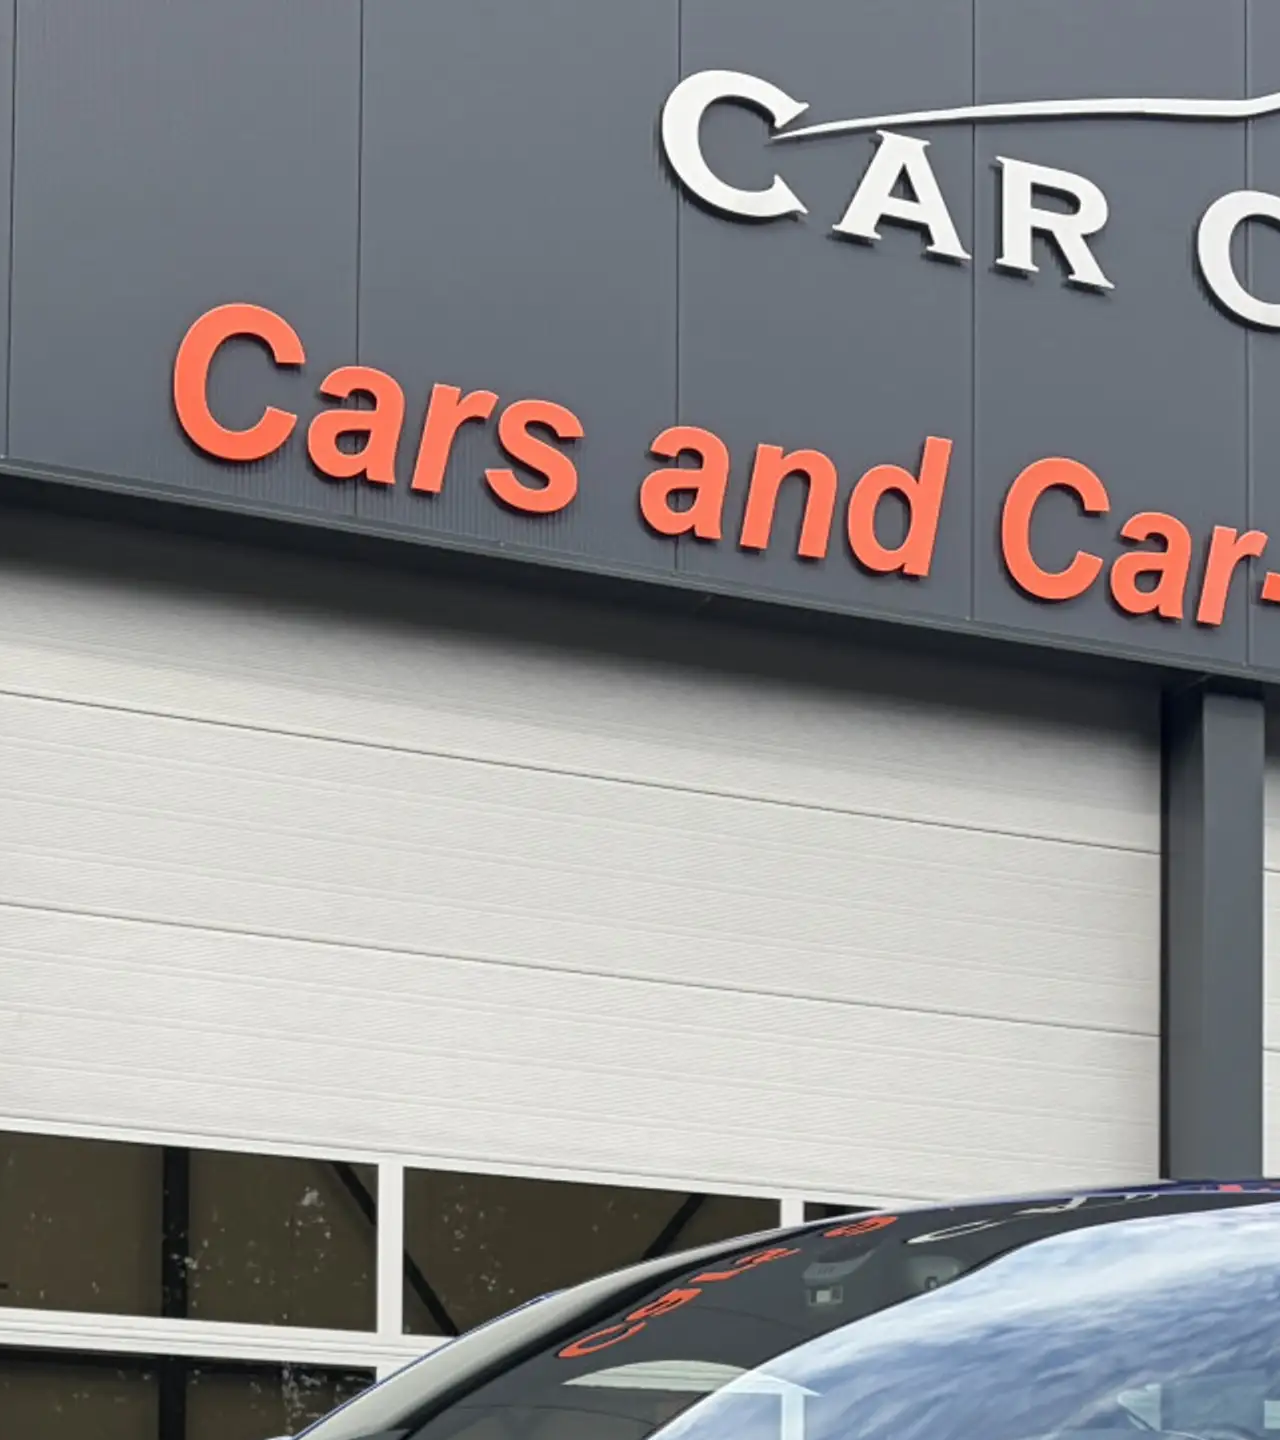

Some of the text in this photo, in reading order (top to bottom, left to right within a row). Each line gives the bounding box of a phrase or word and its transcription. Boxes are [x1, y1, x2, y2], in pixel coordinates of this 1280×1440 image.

[661, 68, 1115, 290] CAR
[173, 303, 585, 514] Cars
[639, 427, 953, 578] and
